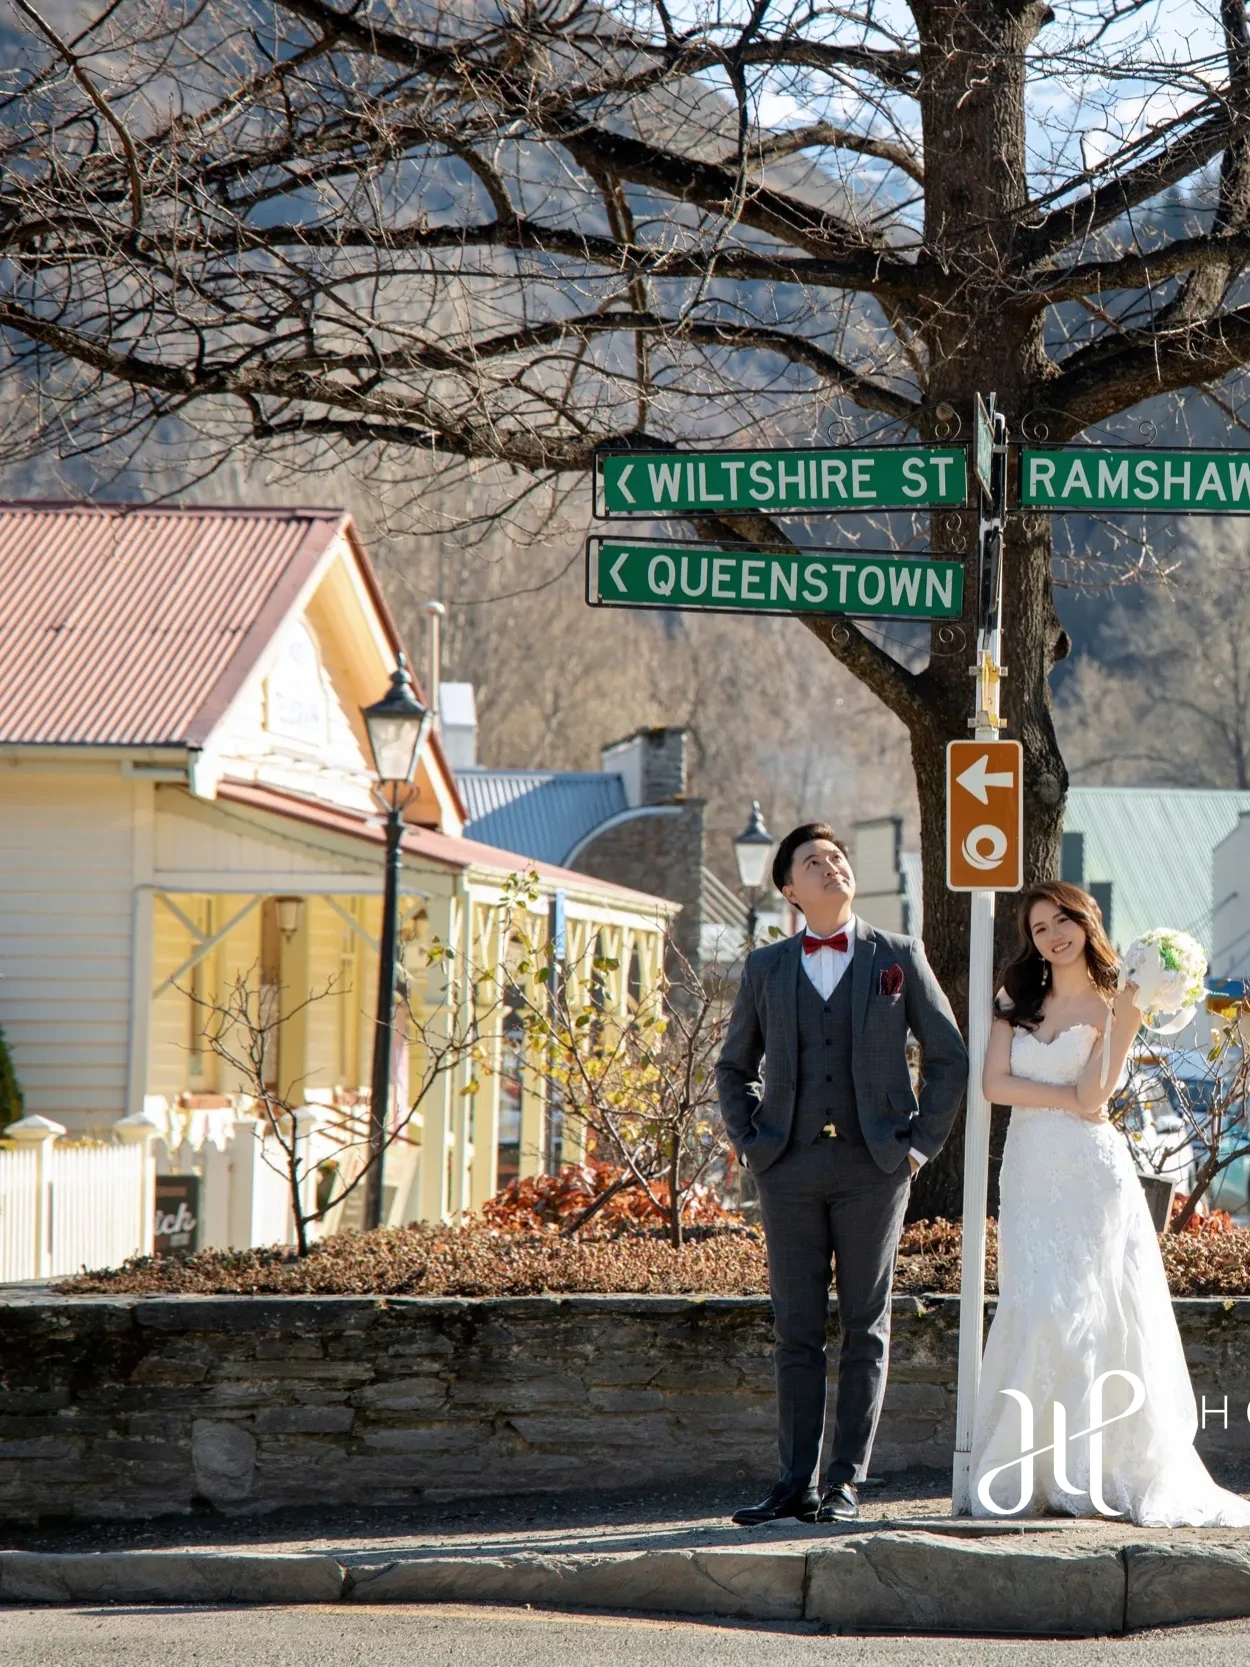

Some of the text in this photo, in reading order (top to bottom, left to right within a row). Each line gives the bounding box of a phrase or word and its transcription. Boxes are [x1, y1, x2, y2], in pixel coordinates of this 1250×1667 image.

[647, 457, 954, 503] WILTSHIRE ST
[647, 554, 953, 608] QUEENSTOWN
